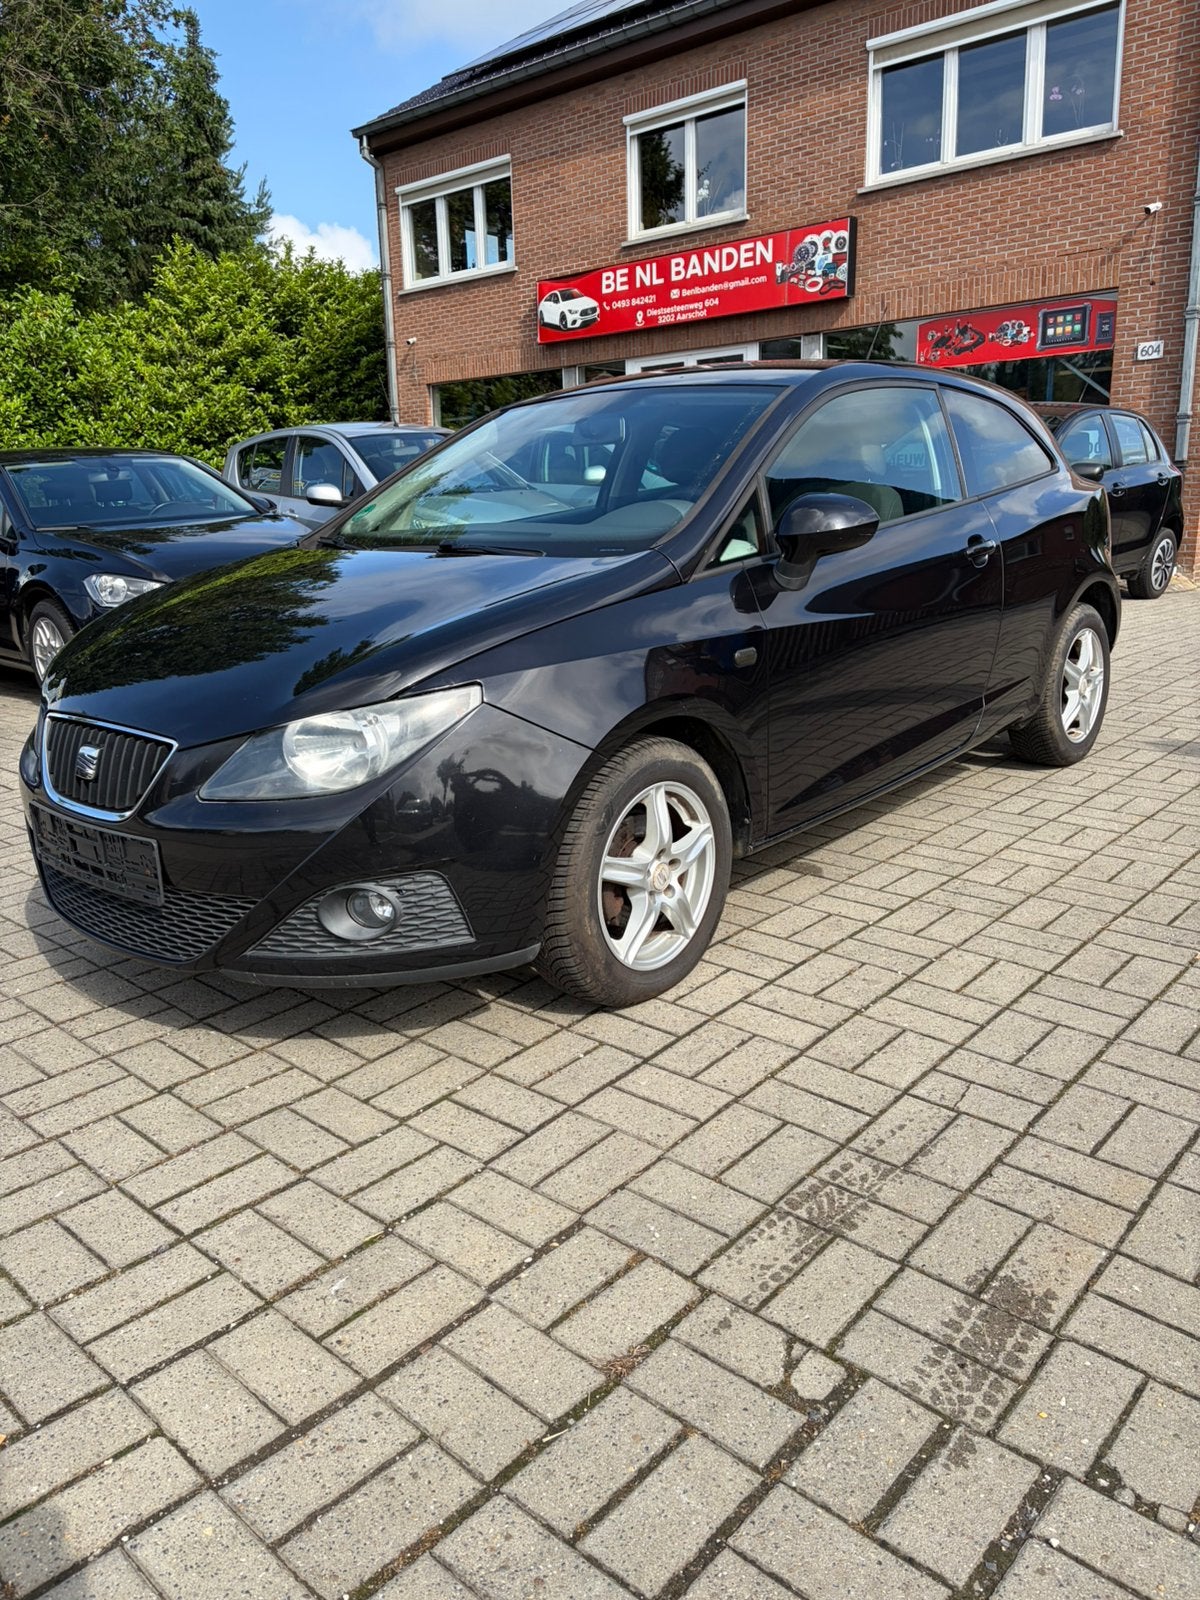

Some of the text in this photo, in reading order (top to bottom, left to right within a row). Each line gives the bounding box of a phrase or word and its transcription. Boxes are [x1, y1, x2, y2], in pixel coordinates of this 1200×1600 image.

[602, 239, 773, 294] BE NL BANDEN
[612, 295, 656, 309] 0493 842421
[646, 297, 719, 317] Diestsesteenweg 604
[657, 309, 707, 324] 3202 Aarschot
[1140, 344, 1160, 357] 604
